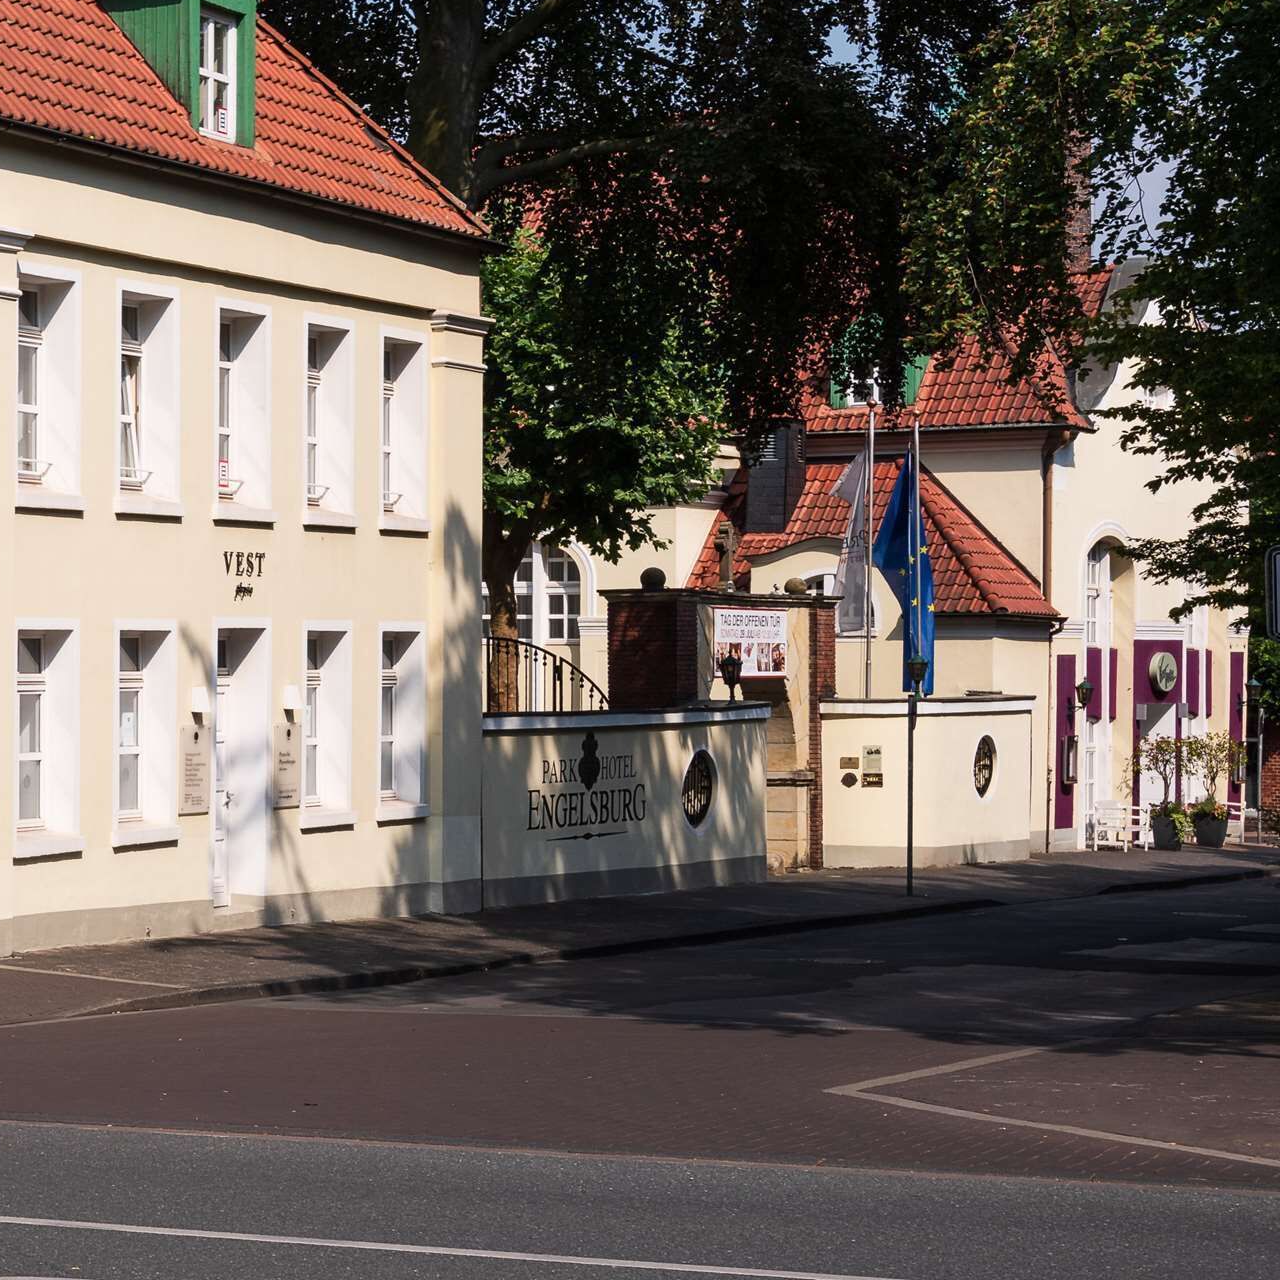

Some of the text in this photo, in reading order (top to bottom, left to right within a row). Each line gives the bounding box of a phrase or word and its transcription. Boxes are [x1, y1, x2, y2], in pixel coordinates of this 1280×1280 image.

[223, 551, 266, 577] VEST
[720, 613, 731, 626] TAG
[732, 614, 743, 627] DER
[745, 614, 769, 627] OFFENEN
[542, 754, 638, 784] PARK HOTEL
